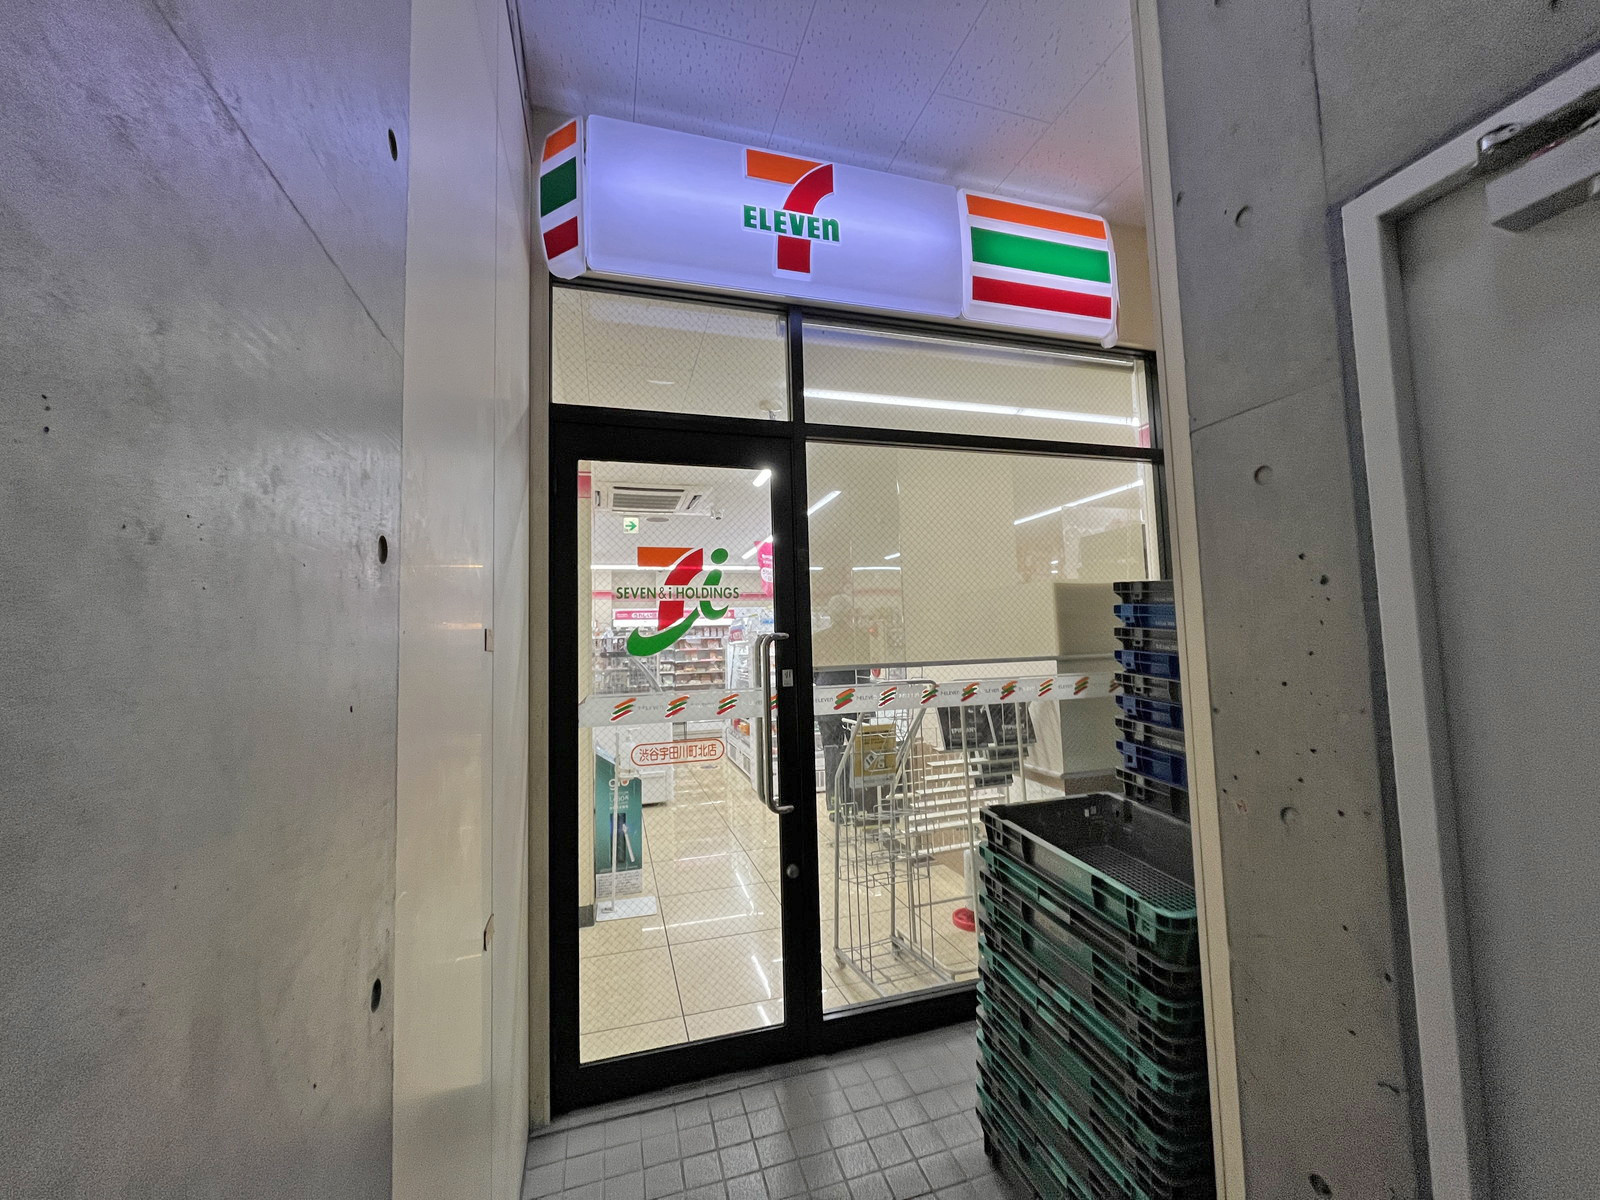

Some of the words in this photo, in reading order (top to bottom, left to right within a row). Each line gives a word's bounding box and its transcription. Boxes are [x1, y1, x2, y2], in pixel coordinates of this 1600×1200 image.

[746, 149, 833, 273] 7
[676, 586, 739, 599] HOLDINGS
[639, 743, 717, 762] 渋谷宇田川町北店
